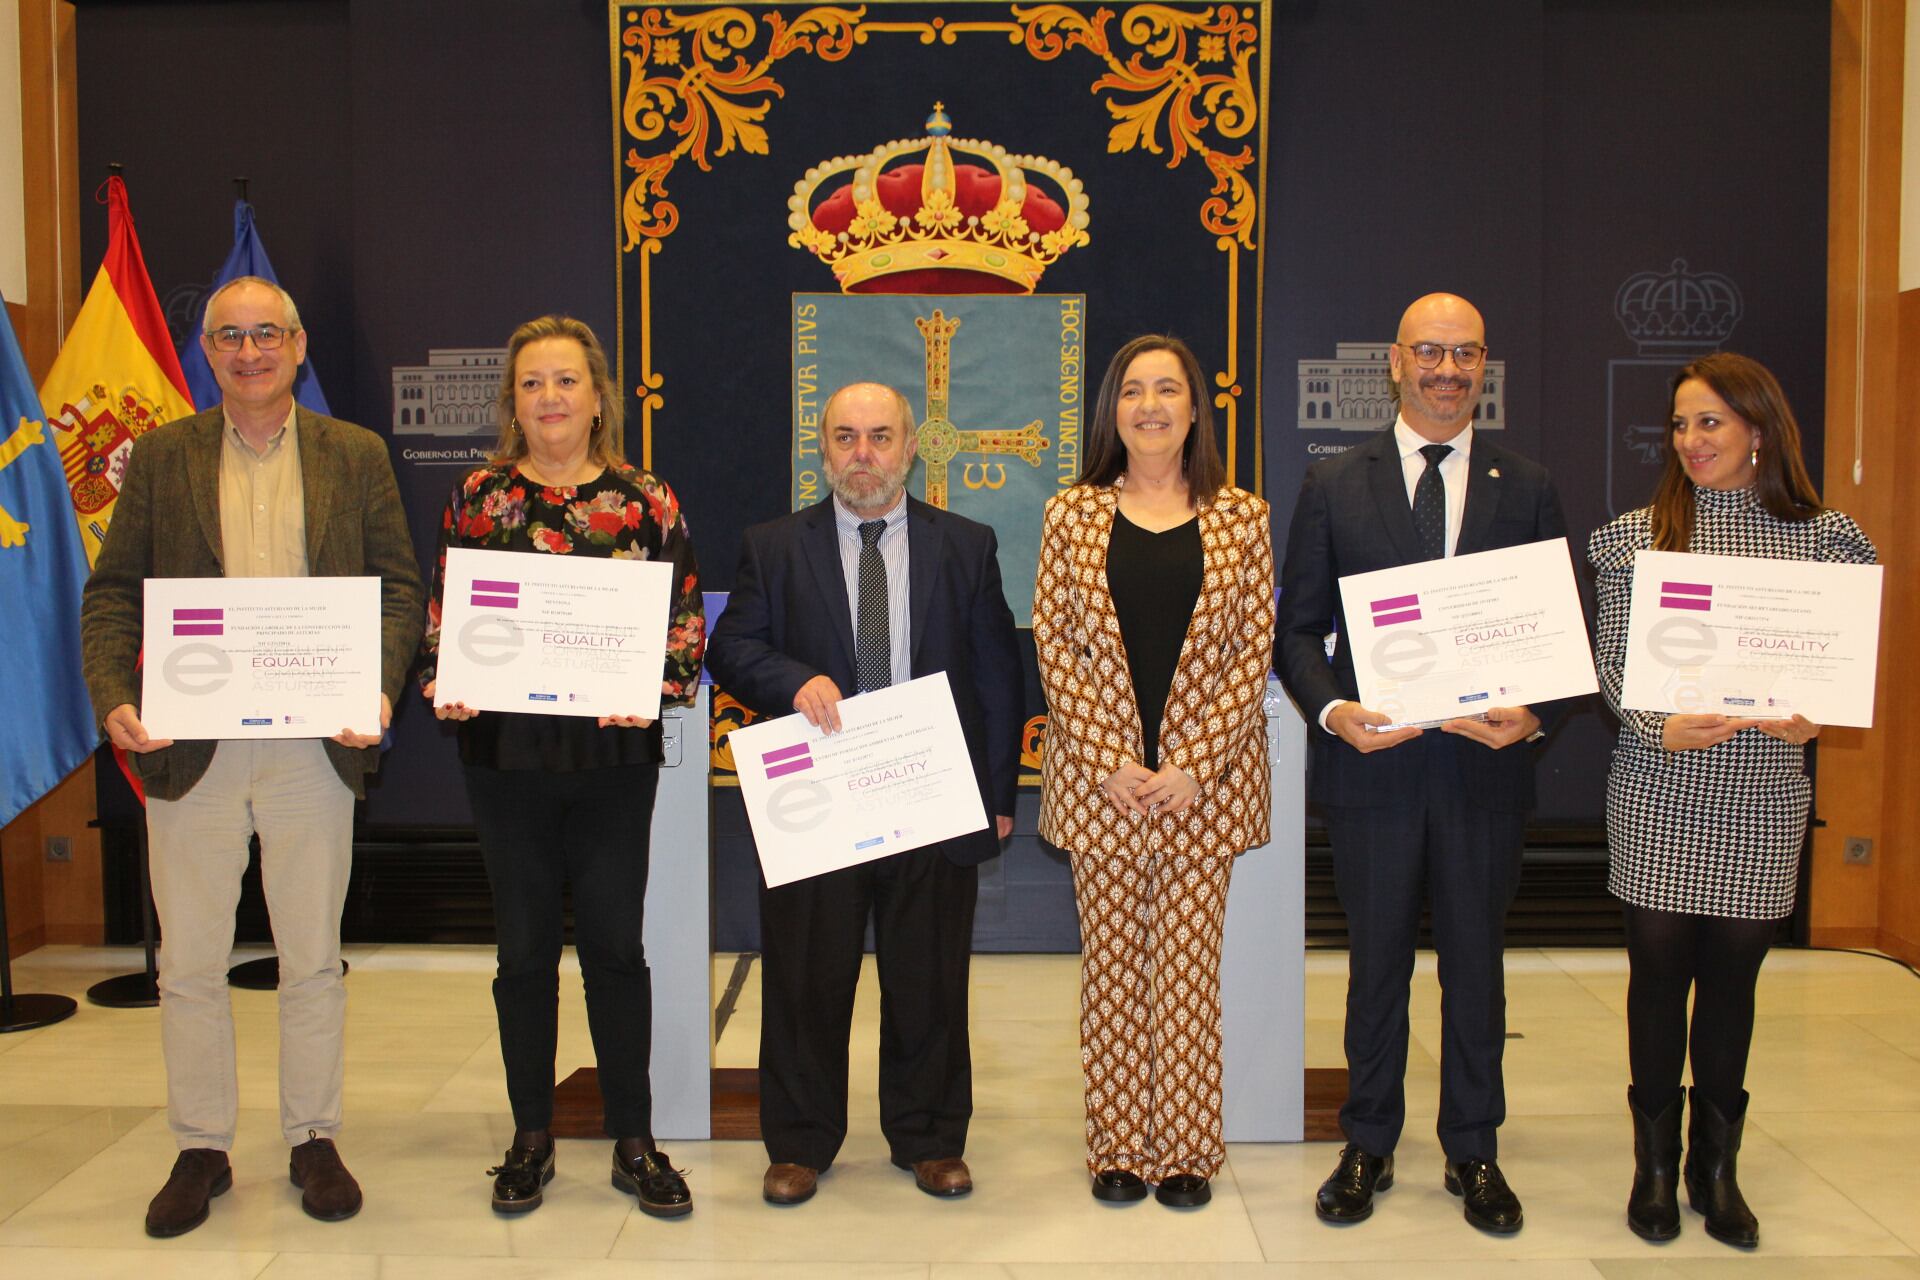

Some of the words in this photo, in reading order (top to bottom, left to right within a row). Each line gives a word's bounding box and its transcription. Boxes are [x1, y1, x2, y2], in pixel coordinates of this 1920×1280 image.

[797, 303, 817, 355] PIVS
[1061, 299, 1080, 342] HOC
[1059, 345, 1080, 404] SIGNO
[798, 364, 818, 459] TVETVR
[403, 448, 452, 460] GOBIERNO
[453, 450, 468, 459] DEL
[1057, 407, 1079, 495] VINCITV
[542, 633, 626, 649] EQUALITY
[1454, 621, 1539, 647] EQUALITY
[1737, 636, 1830, 653] EQUALITY
[252, 656, 339, 668] EQUALITY
[847, 760, 928, 791] EQUALITY
